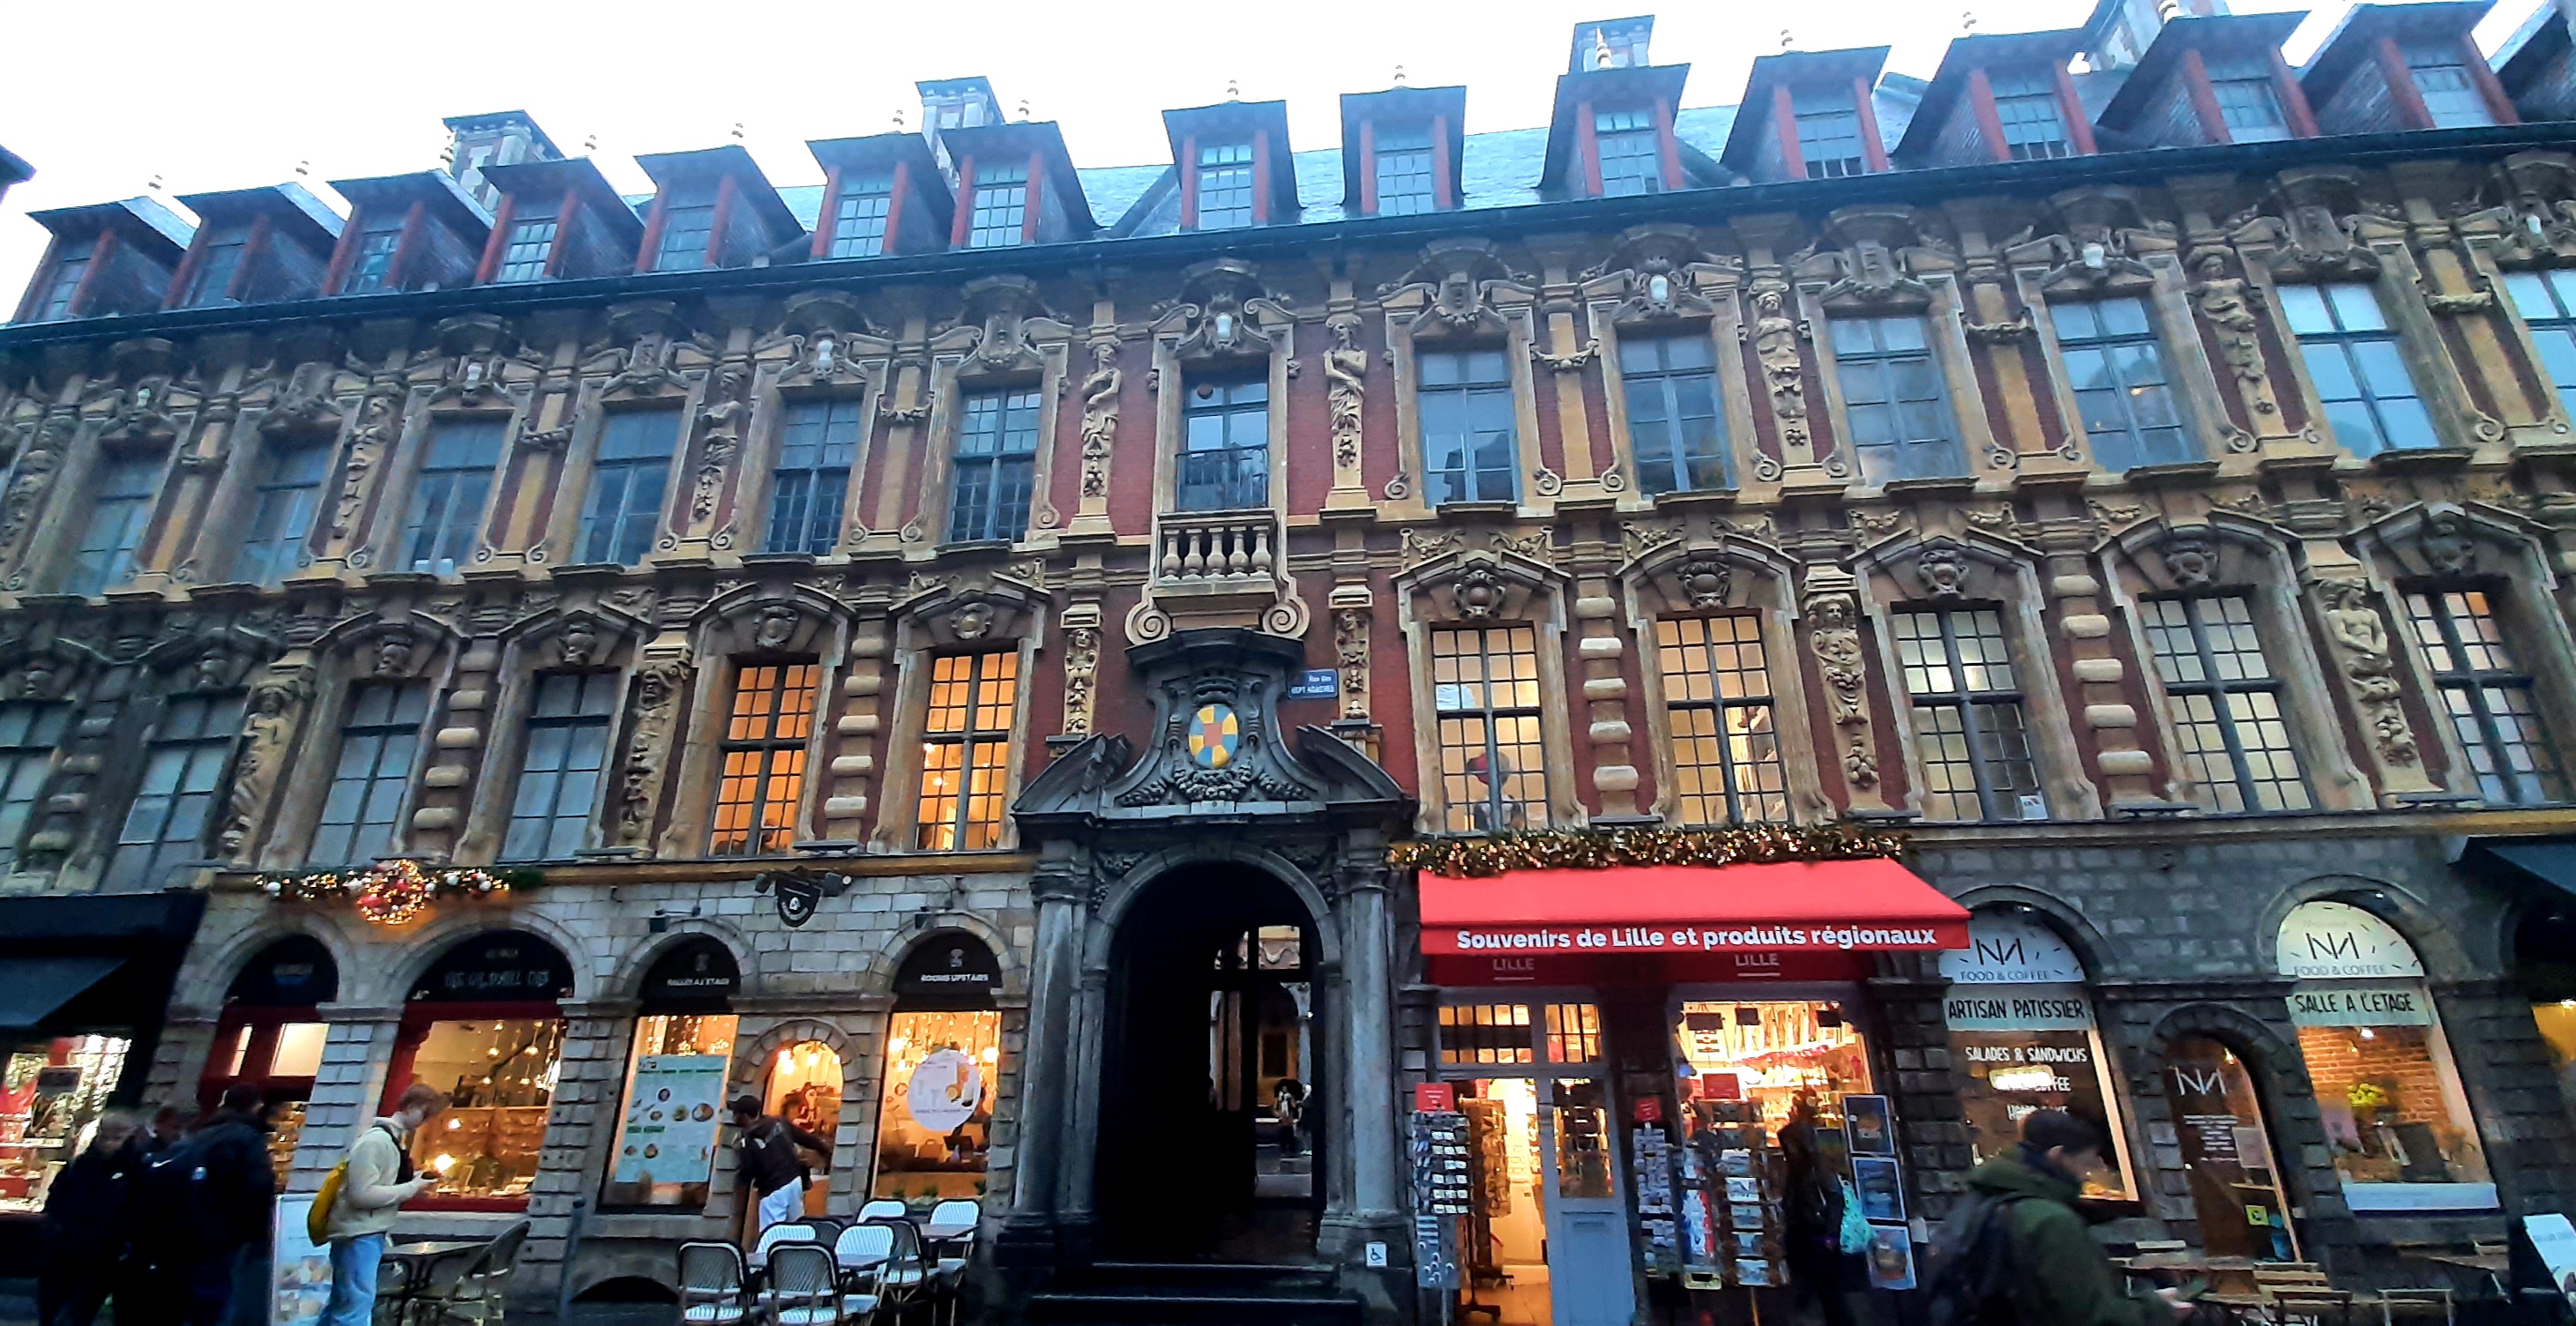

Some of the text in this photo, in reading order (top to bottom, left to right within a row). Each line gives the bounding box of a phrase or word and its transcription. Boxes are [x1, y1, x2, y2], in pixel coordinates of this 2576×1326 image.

[1457, 925, 1938, 950] Souvenirs de Lille et produits régionaux
[1493, 957, 1535, 970] LILLE
[1735, 953, 1780, 966] LILLE
[1960, 971, 1995, 980] FOOD
[2007, 971, 2050, 980] COFFEE
[2294, 965, 2329, 976] FOOD
[2342, 965, 2386, 975] COFFEE
[1949, 999, 2085, 1018] ARTISAN PATISSIER
[2295, 994, 2339, 1013] SALLE
[2346, 994, 2357, 1012] A
[1966, 1047, 2088, 1062] SALADES & SANDWICHS
